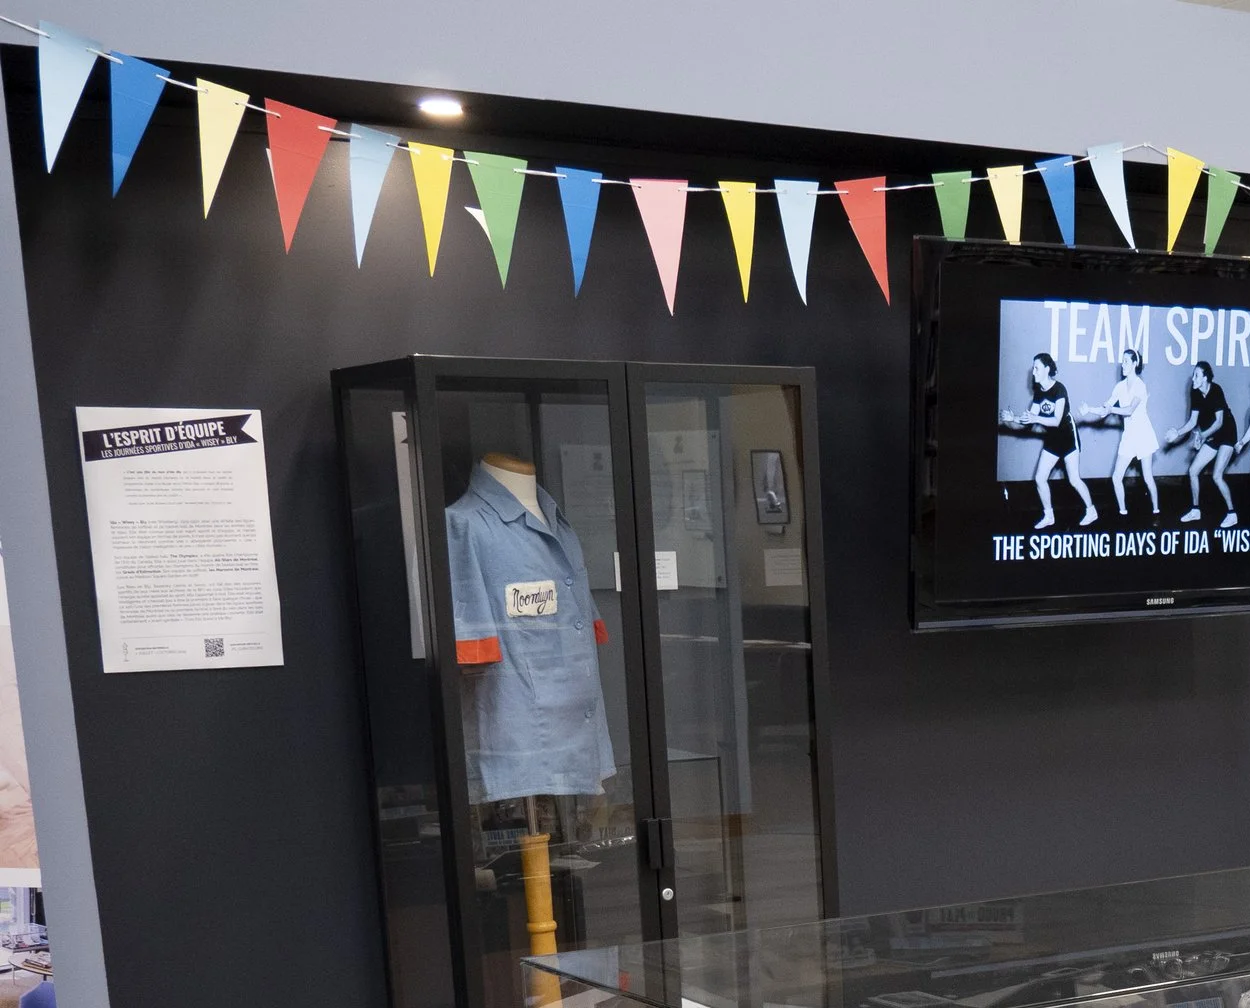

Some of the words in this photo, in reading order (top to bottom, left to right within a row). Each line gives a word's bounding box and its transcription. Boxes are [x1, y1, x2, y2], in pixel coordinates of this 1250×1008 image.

[1044, 301, 1149, 364] TEAM
[101, 450, 113, 459] LES
[114, 446, 145, 457] JOURNÉES
[145, 443, 178, 454] SPORTIVES
[178, 441, 195, 450] D'IDA
[201, 438, 219, 447] WISEY
[226, 436, 238, 445] BLY
[102, 428, 162, 448] L'ESPRIT
[165, 421, 226, 441] D'ÉQUIPE
[993, 536, 1025, 561] THE
[1029, 533, 1110, 559] SPORTING
[1115, 532, 1156, 557] DAYS
[1160, 531, 1180, 555] OF
[1184, 530, 1209, 554] IDA
[1146, 597, 1175, 606] SAMSUNG
